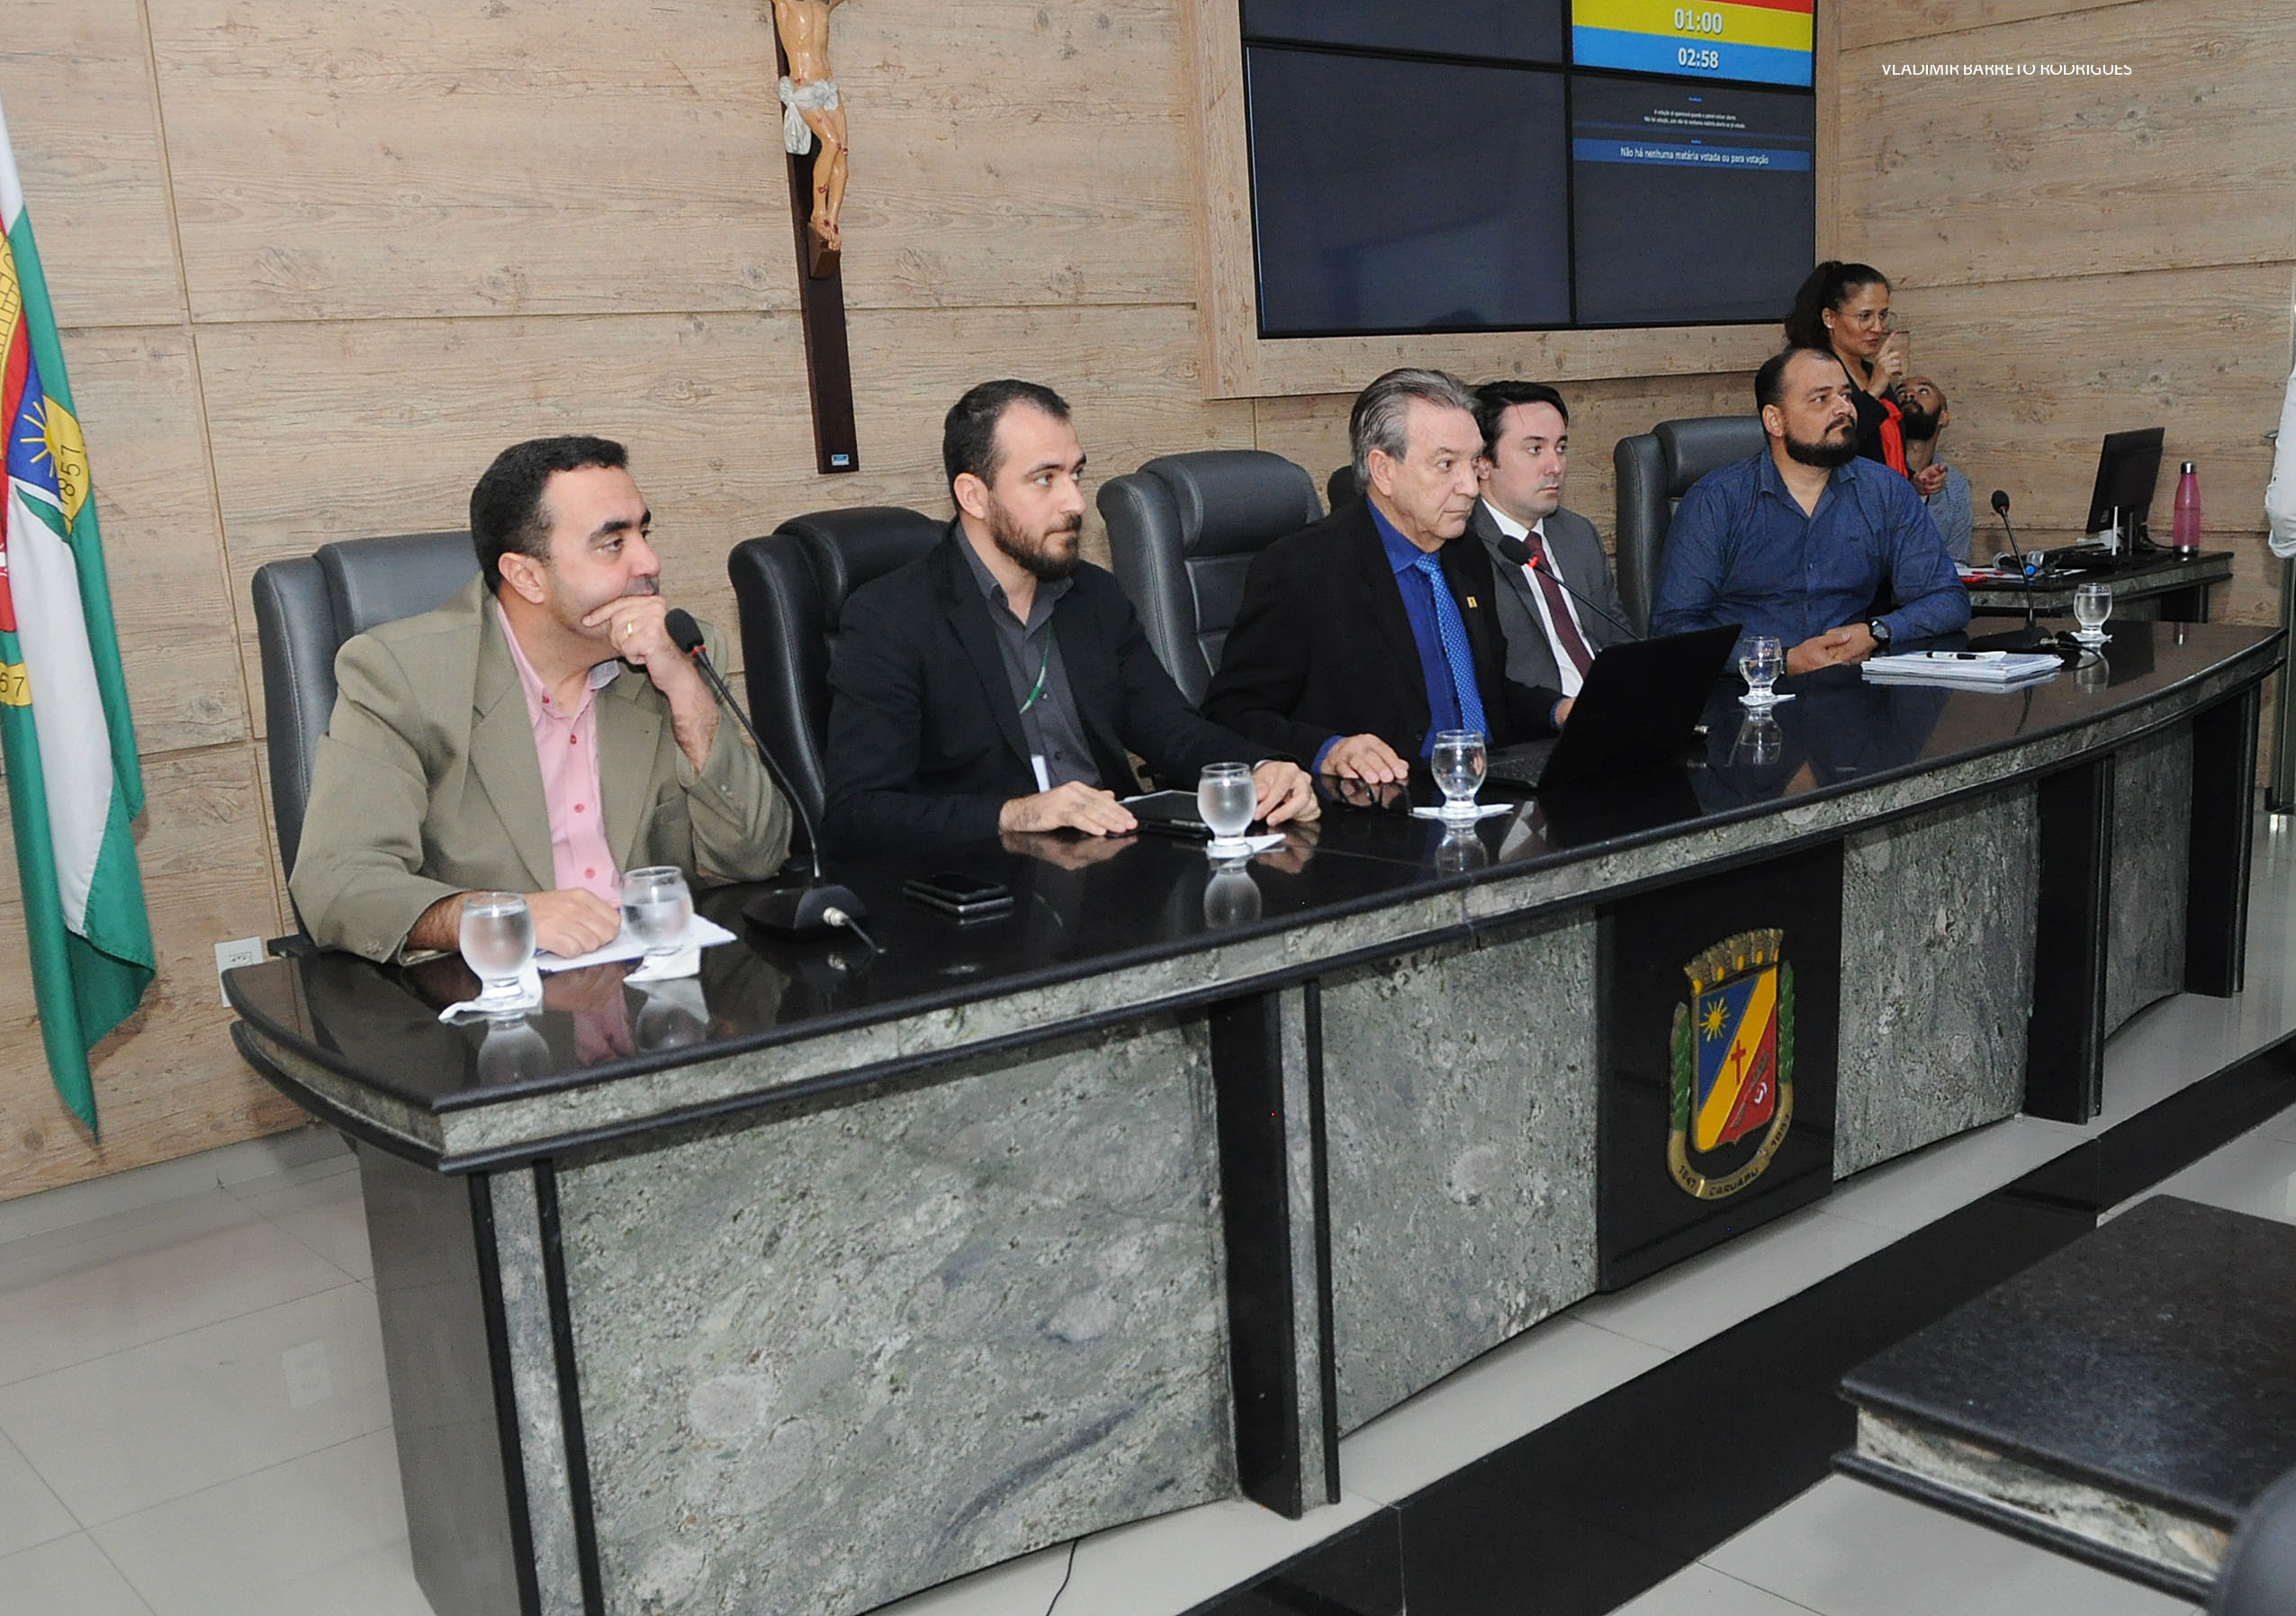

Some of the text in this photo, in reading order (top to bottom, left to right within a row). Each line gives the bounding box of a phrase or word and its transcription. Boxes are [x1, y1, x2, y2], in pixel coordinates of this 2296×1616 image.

[1674, 7, 1723, 33] 01:00
[1678, 47, 1719, 69] 02:58
[1621, 147, 1634, 158] Não
[1634, 148, 1643, 158] há
[1644, 149, 1674, 159] nenhuma
[1675, 149, 1698, 161] matéria
[1700, 152, 1720, 162] votada
[1731, 155, 1744, 164] para
[1746, 154, 1769, 166] votação
